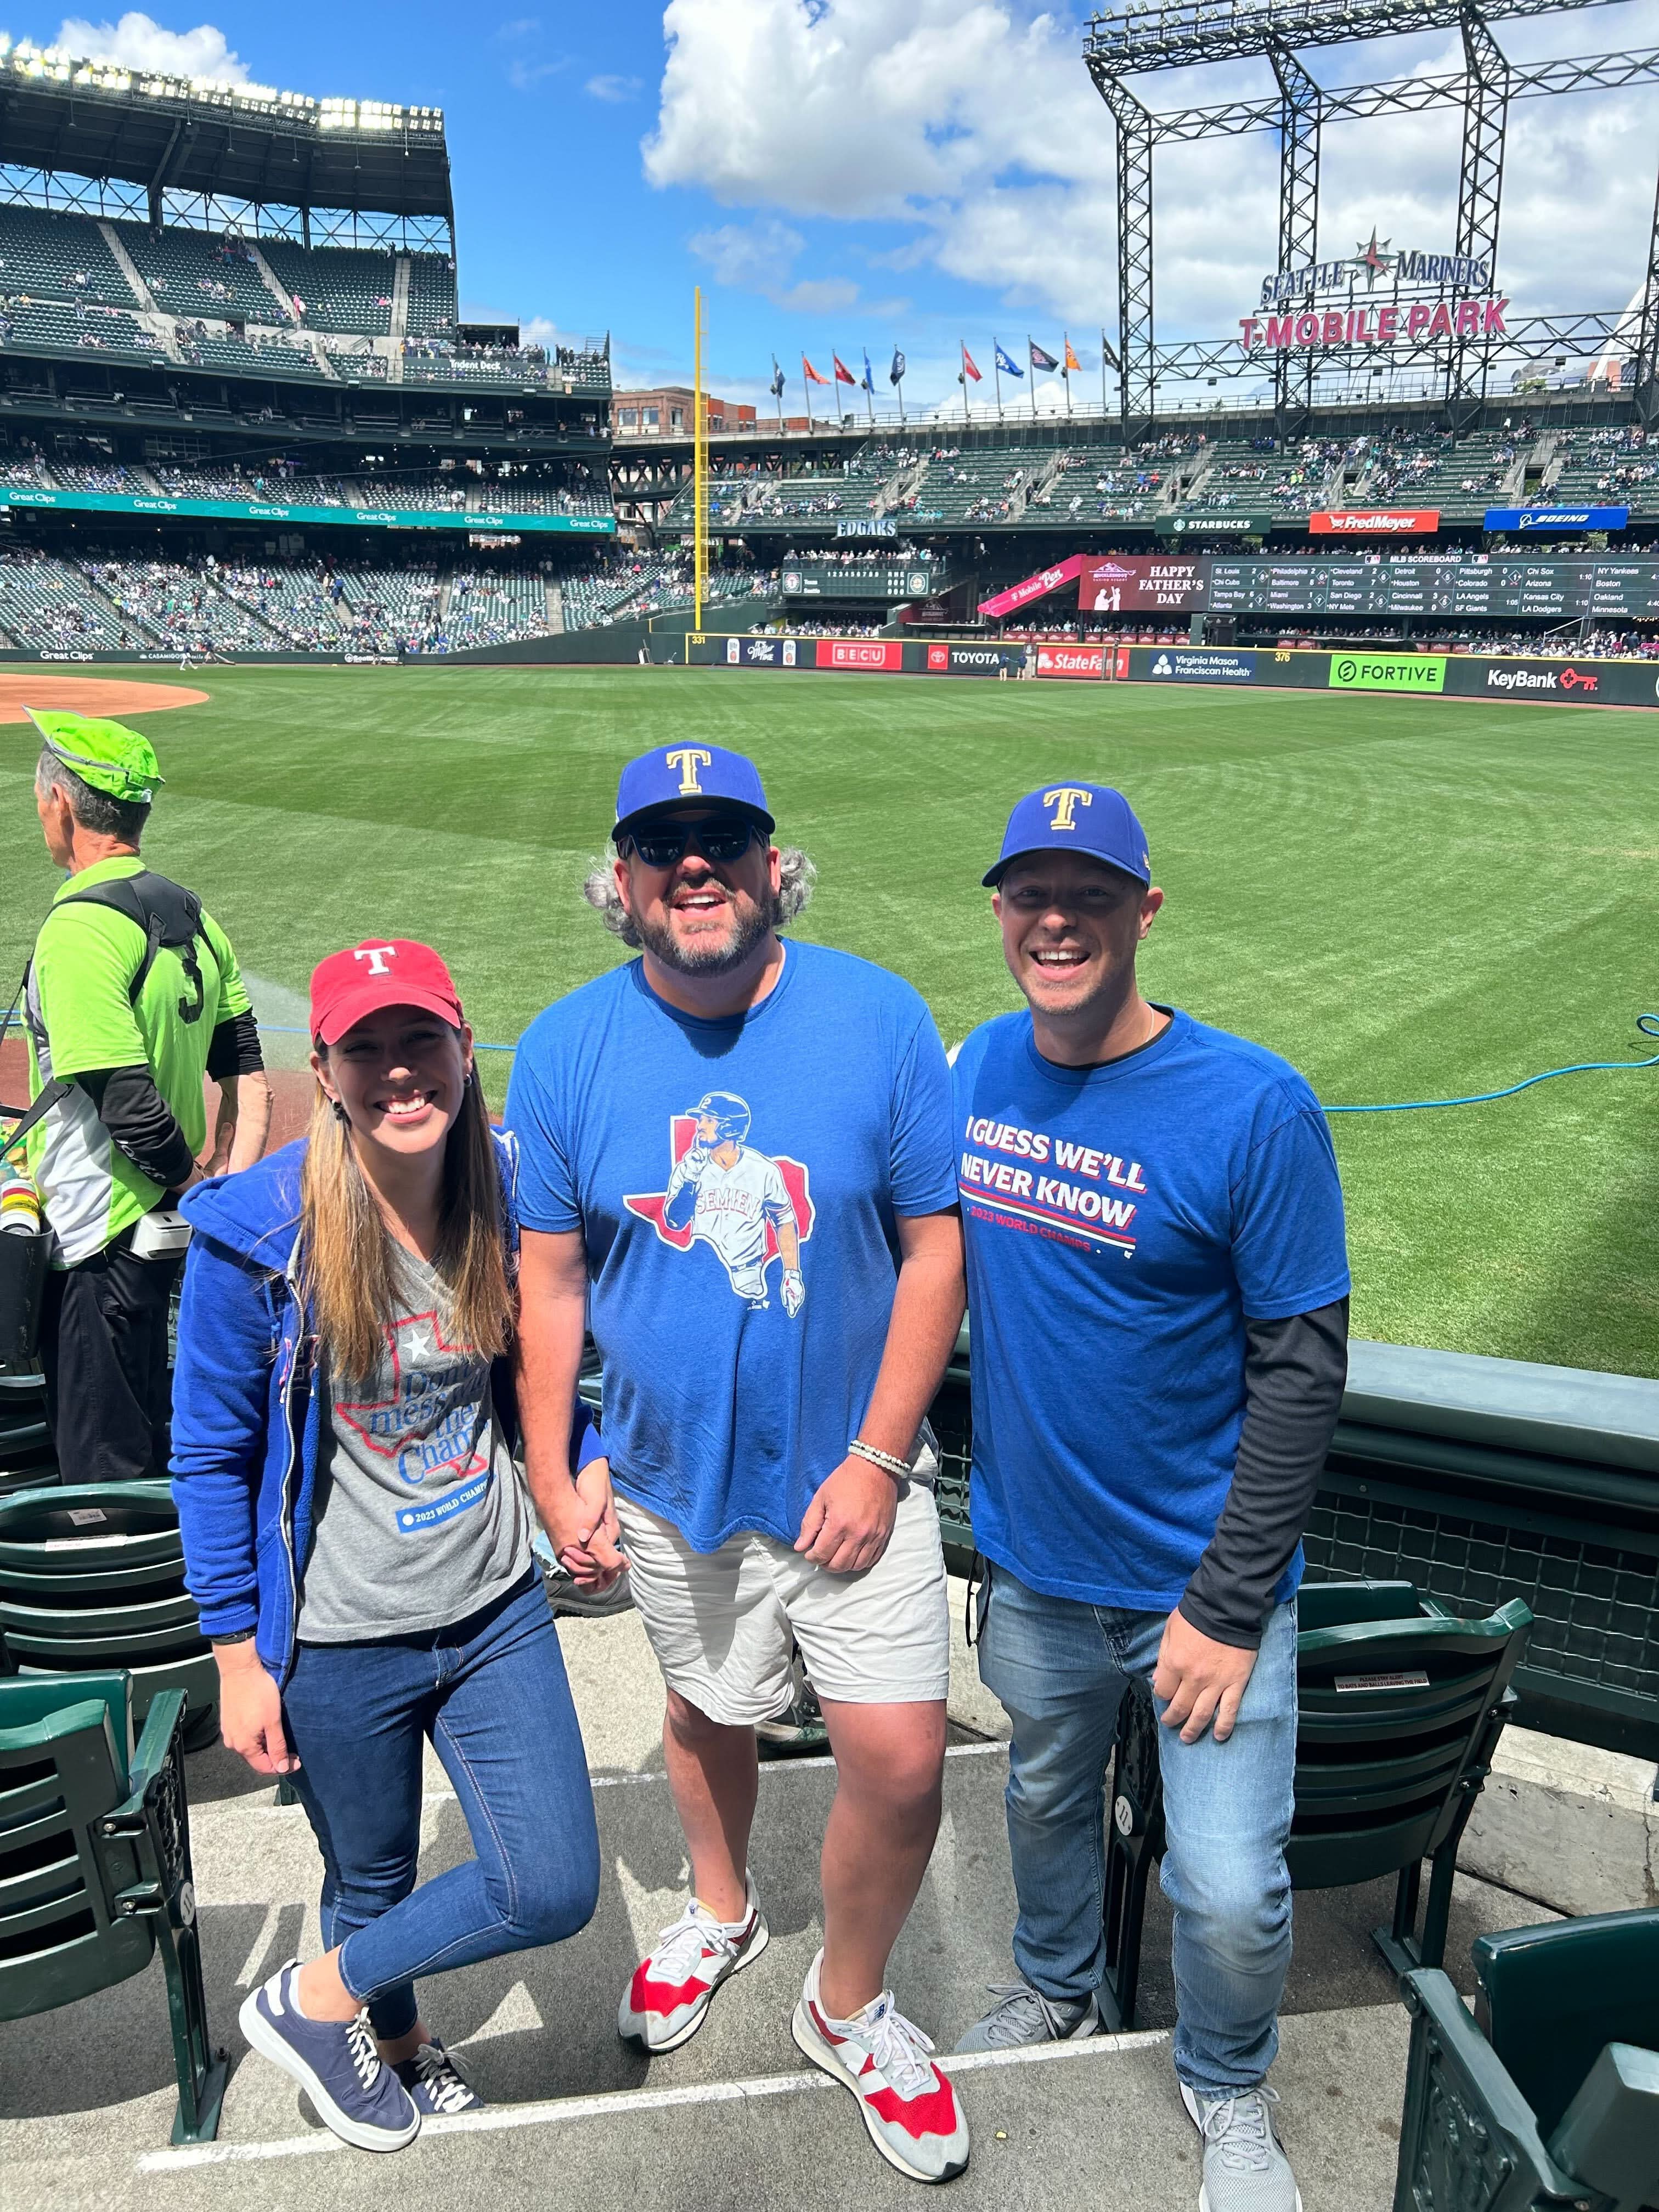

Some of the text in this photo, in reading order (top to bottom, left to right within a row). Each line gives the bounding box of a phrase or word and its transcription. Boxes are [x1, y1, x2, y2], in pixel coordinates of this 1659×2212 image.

[1260, 250, 1491, 306] SEATTLE MARINERS
[1239, 298, 1510, 351] T-MOBILE PARK
[449, 359, 501, 371] Trident Deck
[9, 492, 55, 504] Great Clips
[134, 499, 177, 511] Great Clips
[249, 506, 290, 517] Great Clips
[357, 512, 397, 522] Great Clips
[486, 517, 504, 526] Clips
[591, 520, 608, 528] Clips
[1188, 520, 1251, 529] STARBUCKS
[1536, 514, 1589, 523] BOEING
[837, 521, 896, 537] EDGARS
[1150, 566, 1195, 578] HAPPY
[1459, 568, 1492, 576] Pittsburgh
[1018, 582, 1042, 598] Mobile
[1138, 579, 1204, 591] FATHER’S
[1156, 593, 1184, 604] DAY
[1344, 592, 1362, 600] Diego
[1550, 593, 1564, 601] City
[1532, 606, 1562, 614] Dodgers
[692, 636, 706, 644] 331
[40, 650, 94, 663] Great Clips
[747, 644, 775, 660] Miller
[837, 648, 881, 661] BECU
[1274, 651, 1290, 662] 376
[952, 652, 1000, 665] TOYOTA
[1176, 656, 1239, 667] Virginia Mason
[1175, 665, 1252, 677] Franciscan Health
[1361, 664, 1437, 682] FORTIVE
[1487, 669, 1557, 690] KeyBank
[665, 749, 712, 795] T
[1043, 788, 1093, 831] T
[354, 946, 399, 978] T
[703, 1098, 712, 1109] 2
[965, 1115, 974, 1141] I
[973, 1118, 1050, 1163] GUESS
[961, 1152, 1137, 1231] NEVER KNOW
[696, 1187, 763, 1220] SEMIEN
[969, 1205, 1092, 1252] 2023 WORLD CHAMPS
[415, 1510, 436, 1523] 2023
[435, 1498, 460, 1516] WORLD
